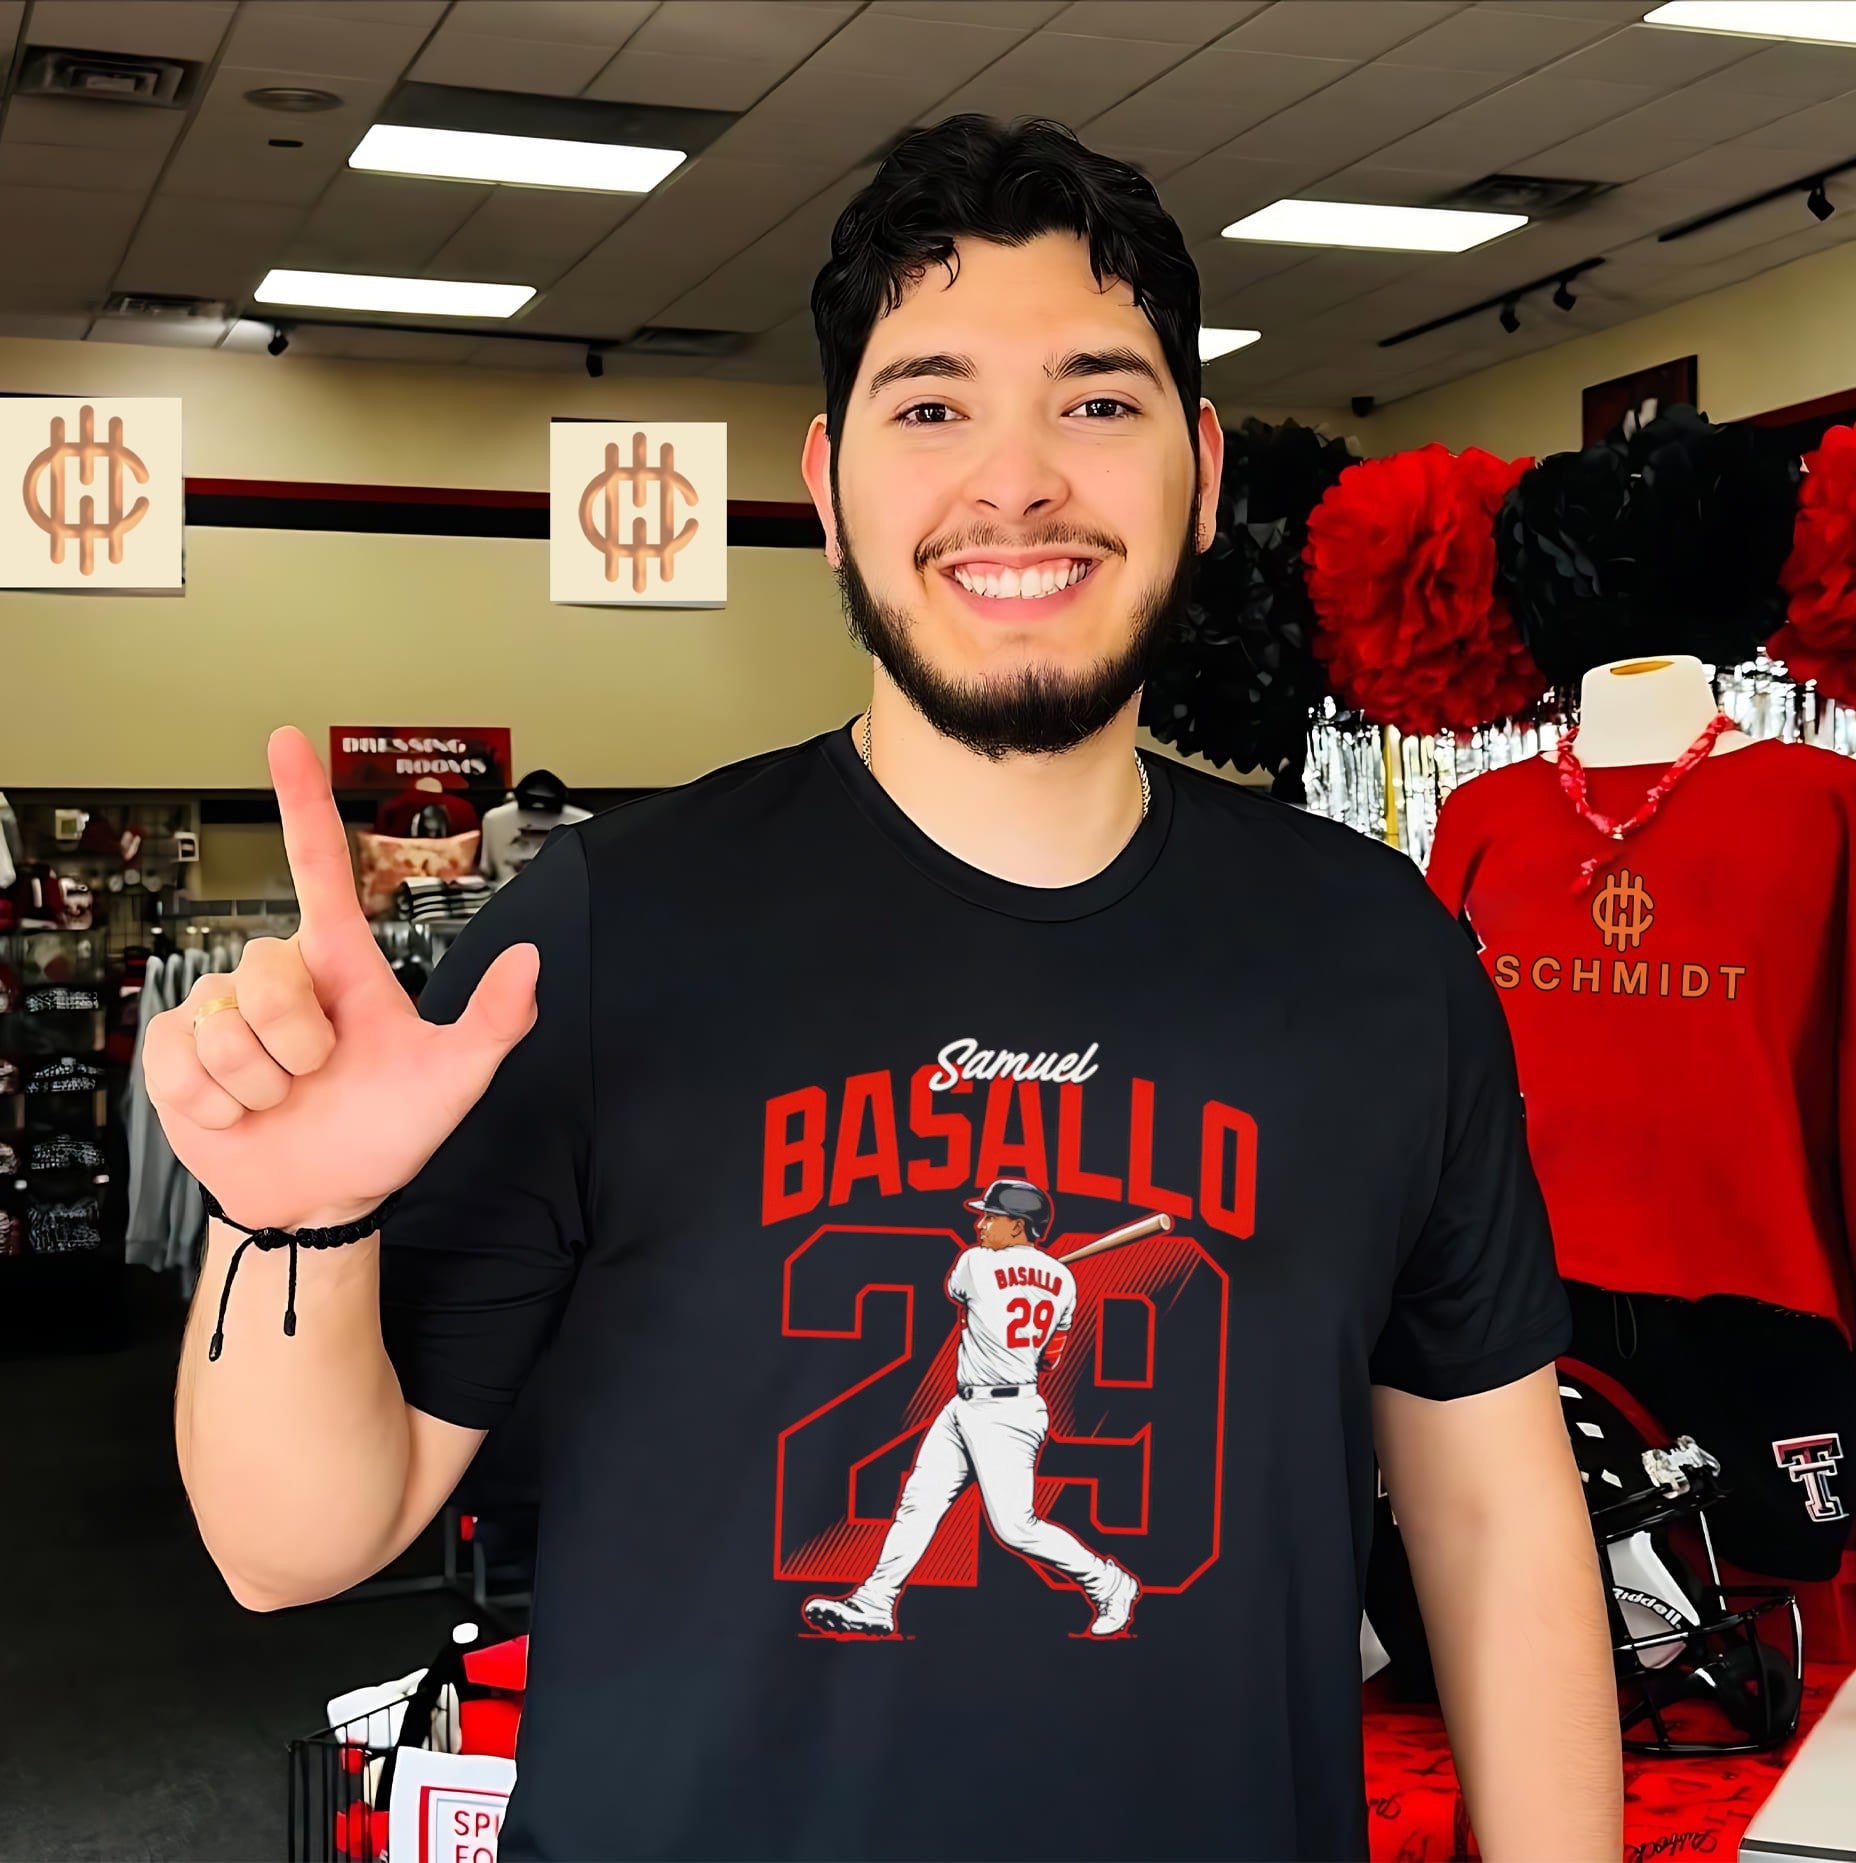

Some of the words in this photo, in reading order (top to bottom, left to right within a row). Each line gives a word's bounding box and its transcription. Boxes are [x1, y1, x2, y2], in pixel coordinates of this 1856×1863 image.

[342, 737, 467, 754] DRESSING
[396, 758, 487, 775] ROOMS
[1494, 954, 1747, 1001] SCHMIDT
[928, 1037, 1100, 1092] Samuel
[761, 1064, 1259, 1241] BASALLO
[994, 1266, 1063, 1297] BASALLO
[1006, 1297, 1054, 1349] 29
[774, 1224, 1230, 1594] 29
